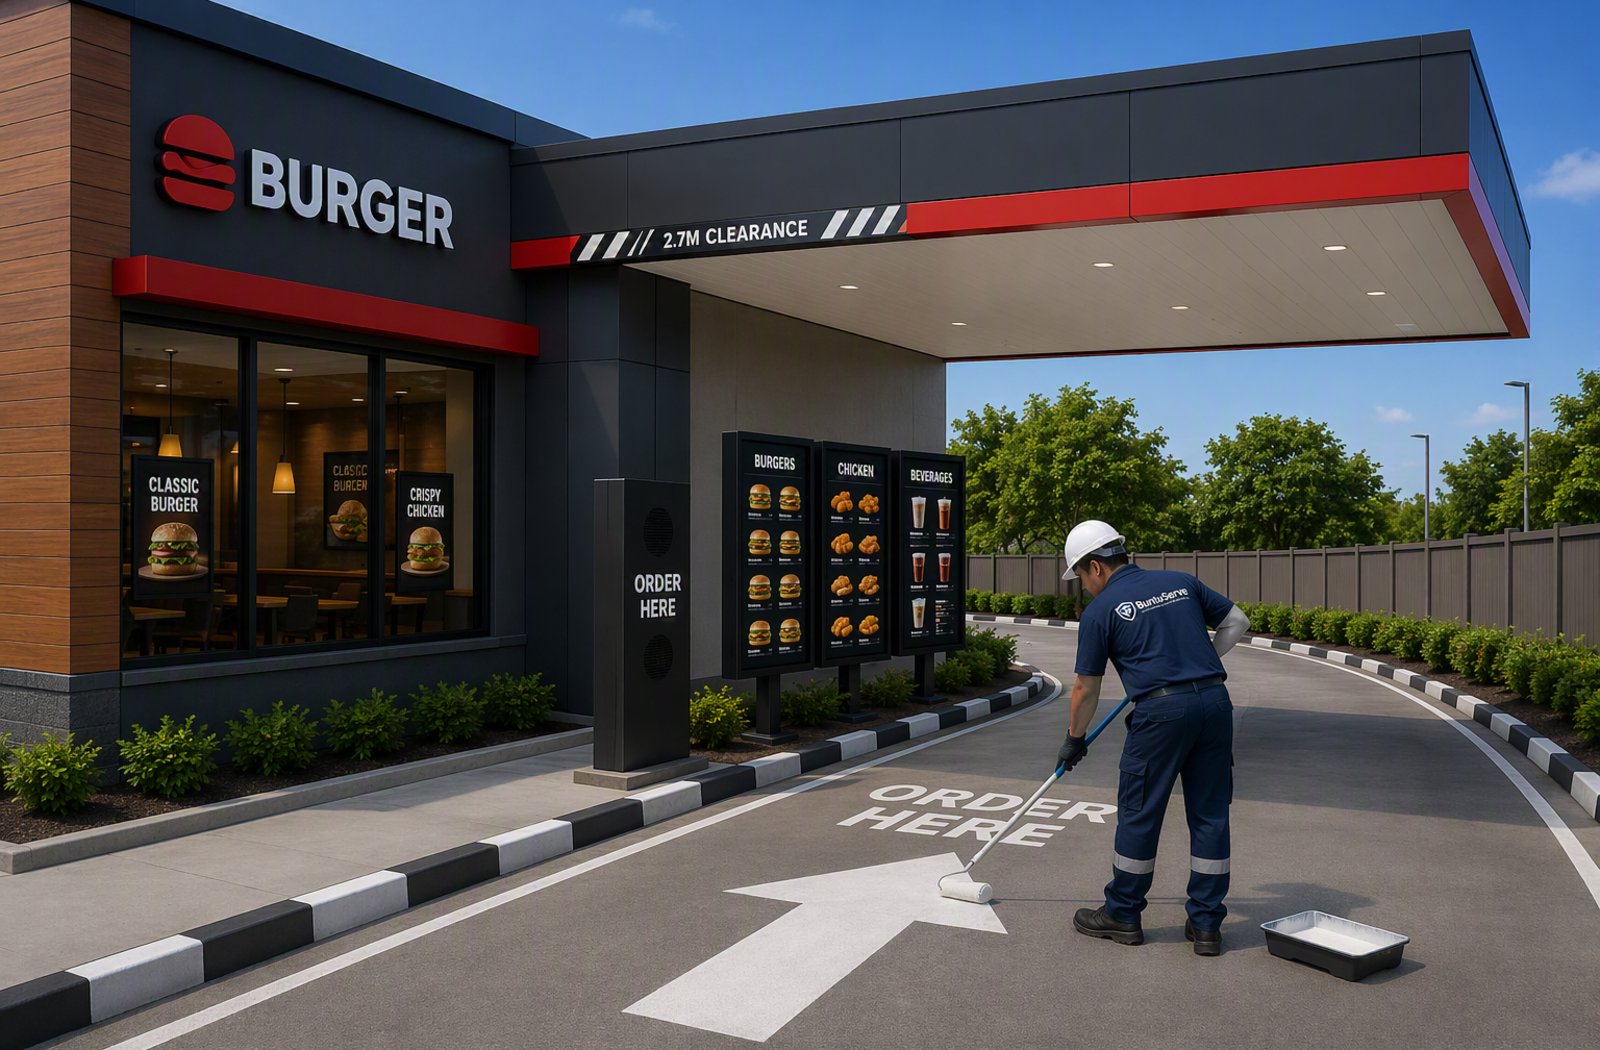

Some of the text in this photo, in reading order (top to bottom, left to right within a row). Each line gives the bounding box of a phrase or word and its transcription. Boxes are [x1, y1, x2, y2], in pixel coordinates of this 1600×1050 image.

[251, 148, 454, 249] BURGER
[663, 219, 808, 249] 2.7M CLEARANCE
[754, 453, 796, 471] BURGERS
[837, 462, 875, 478] CHICKEN
[149, 476, 199, 495] CLASSIC
[910, 469, 953, 484] BEVERAGES
[151, 496, 198, 513] BURGER
[410, 487, 441, 503] CRISPY
[407, 503, 445, 519] CHICKEN
[634, 573, 682, 594] ORDER
[640, 598, 676, 619] HERE
[1135, 588, 1189, 610] BuntuServe
[868, 784, 1119, 824] ORDER
[835, 806, 1066, 848] HERE
